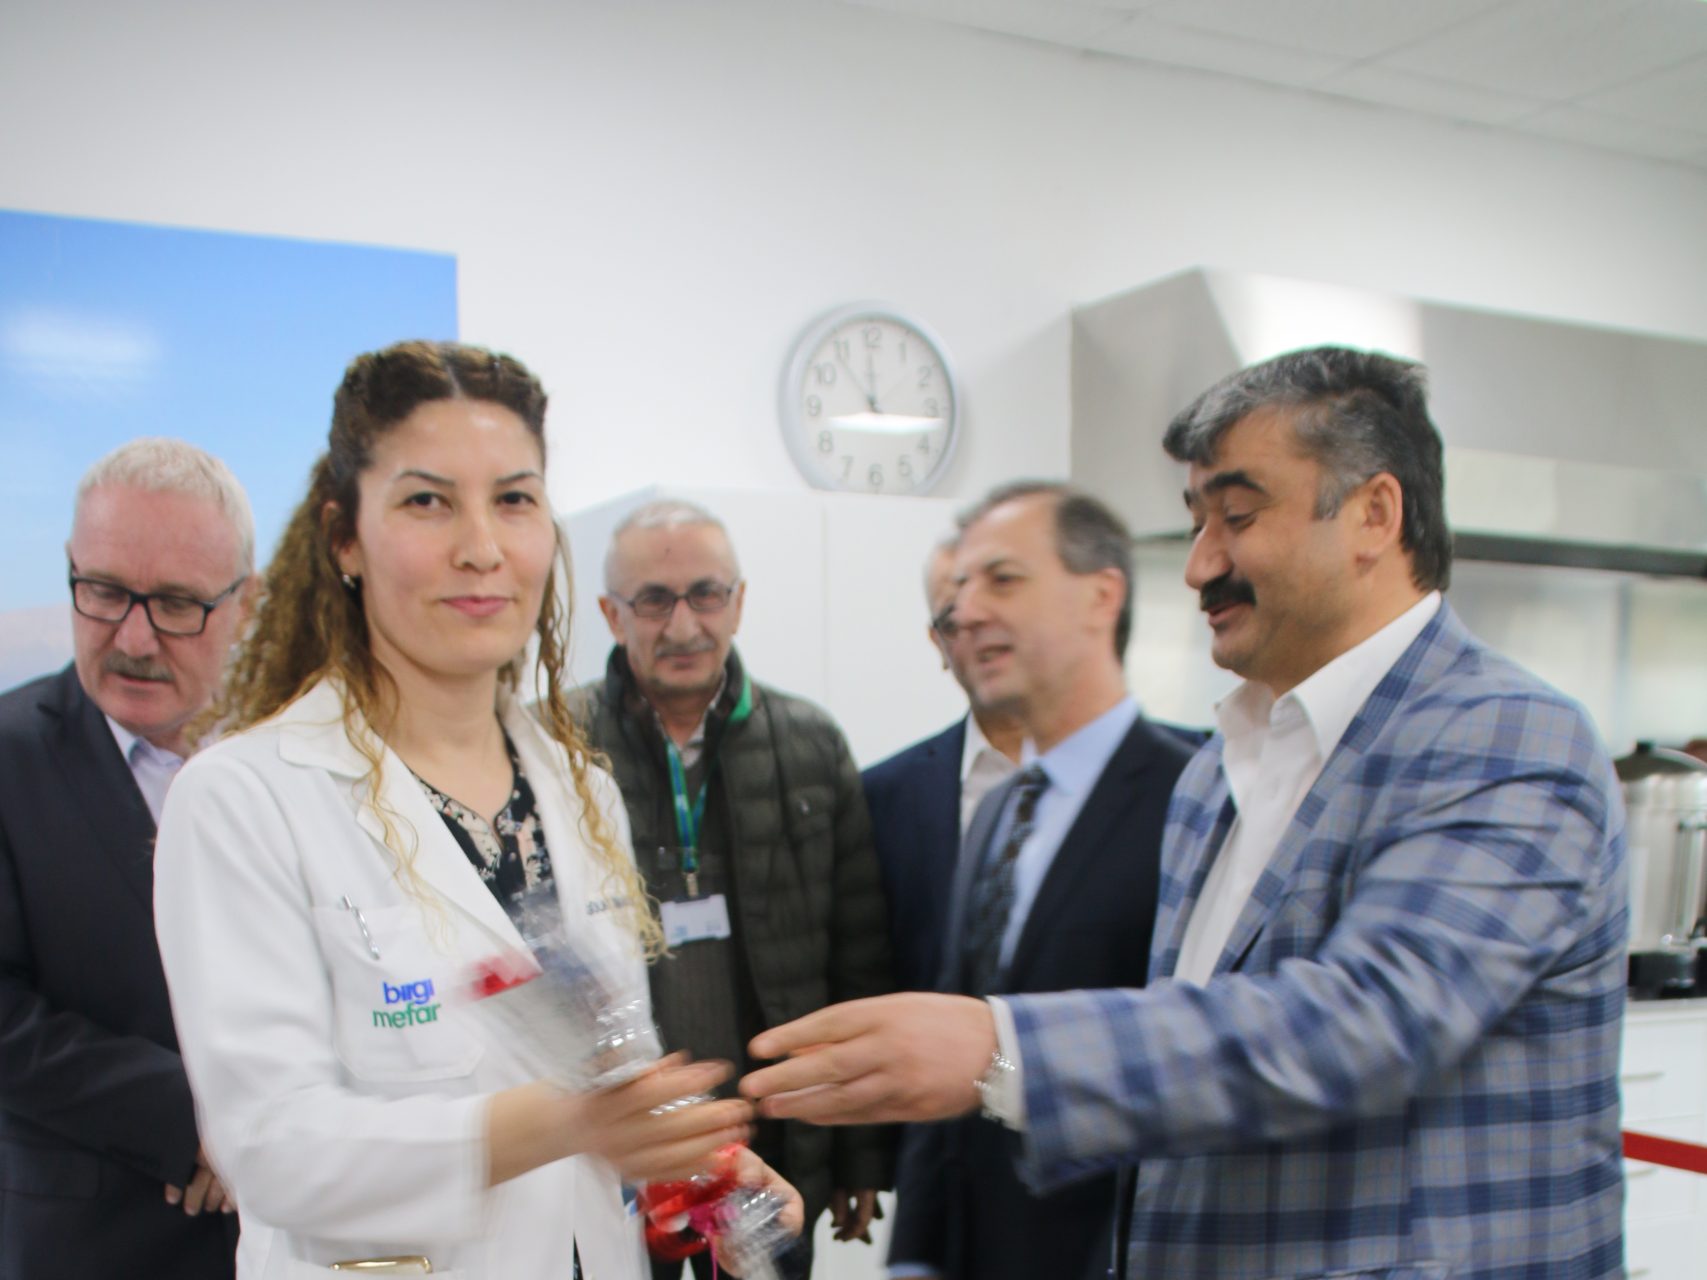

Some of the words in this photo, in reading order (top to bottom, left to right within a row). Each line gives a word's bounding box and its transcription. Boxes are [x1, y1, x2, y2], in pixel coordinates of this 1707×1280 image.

[862, 326, 882, 348] 12
[834, 338, 850, 361] 11
[898, 342, 907, 363] 1
[814, 362, 836, 385] 10
[917, 366, 932, 388] 2
[806, 394, 822, 417] 9
[924, 398, 939, 418] 3
[818, 430, 834, 453] 8
[917, 433, 930, 455] 4
[841, 455, 854, 478] 7
[868, 463, 884, 486] 6
[898, 454, 912, 477] 5
[372, 1002, 442, 1028] mefar
